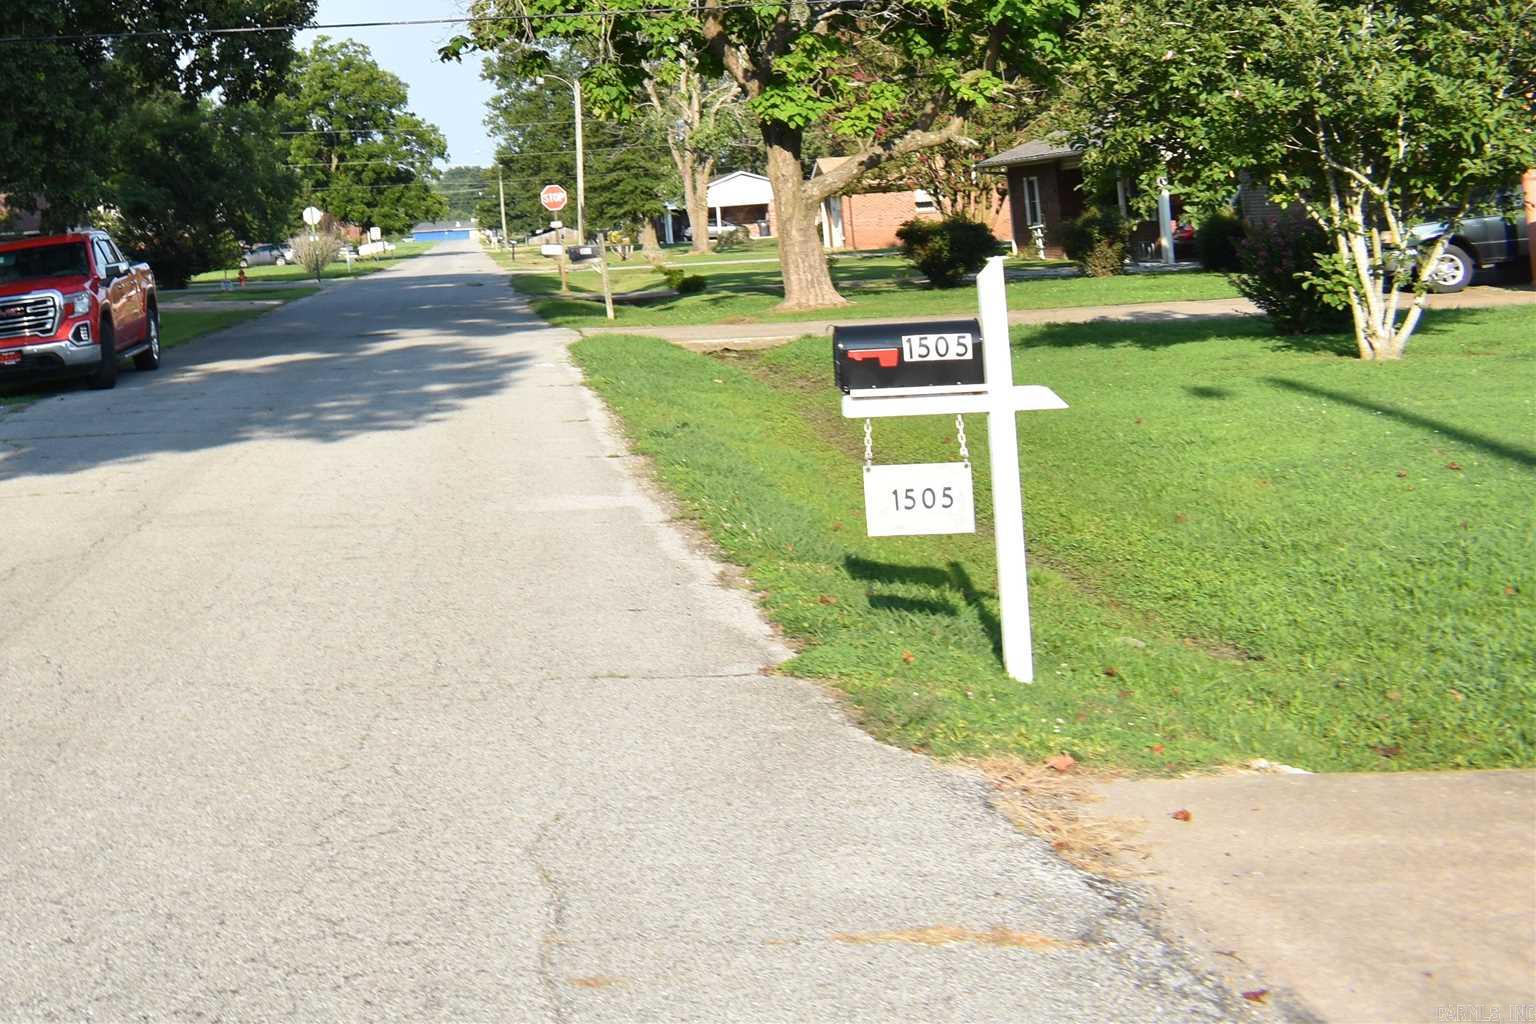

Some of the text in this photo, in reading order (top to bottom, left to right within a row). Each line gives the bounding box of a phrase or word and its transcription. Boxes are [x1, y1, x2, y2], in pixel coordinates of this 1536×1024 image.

[543, 192, 565, 202] STOP
[905, 334, 969, 360] 1505
[892, 486, 955, 512] 1505
